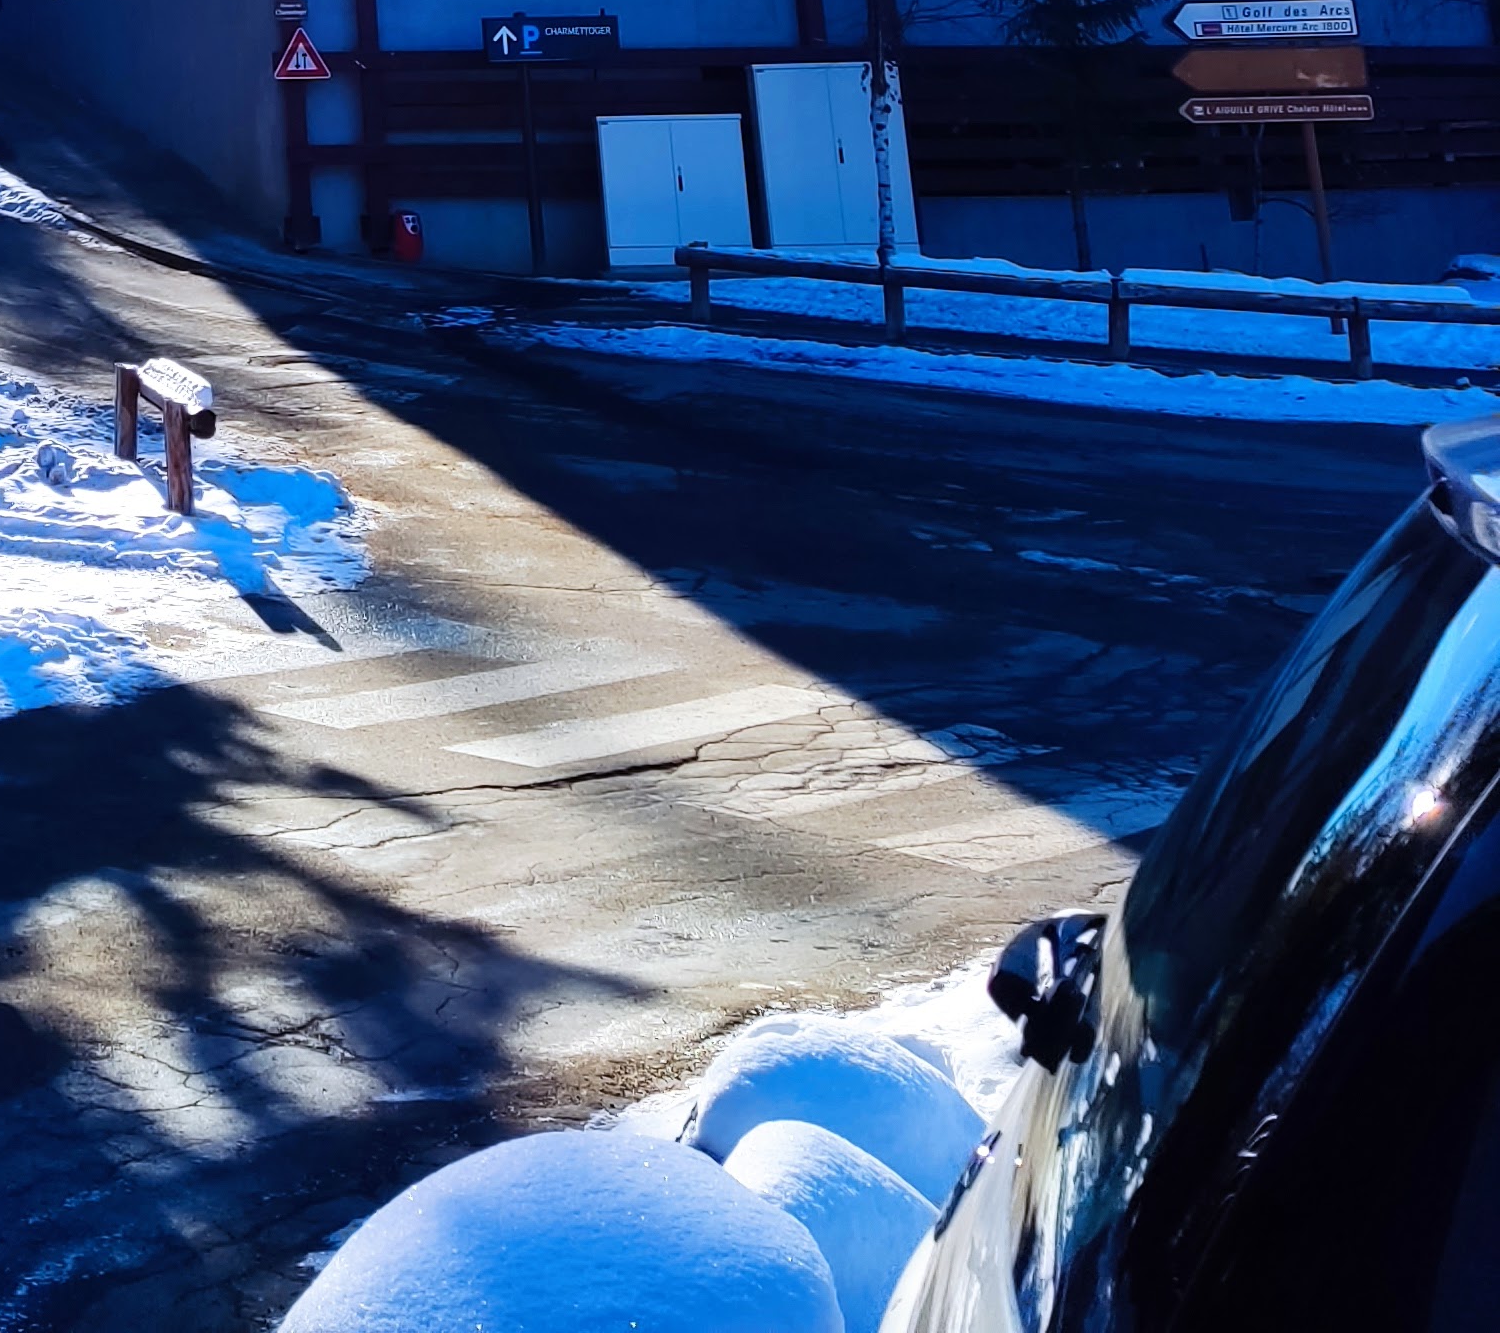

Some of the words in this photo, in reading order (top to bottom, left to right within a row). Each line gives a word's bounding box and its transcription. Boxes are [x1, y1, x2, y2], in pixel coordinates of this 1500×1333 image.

[1242, 6, 1273, 18] Golf
[1284, 5, 1308, 17] des
[1320, 4, 1350, 16] Arcs
[1227, 24, 1254, 33] Hôtel
[1257, 23, 1298, 33] Mercure
[1301, 22, 1319, 32] Arc
[1322, 21, 1348, 31] 1800
[521, 25, 540, 49] P
[545, 26, 611, 36] CHARMETTOGER
[1257, 104, 1284, 114] GRIVE
